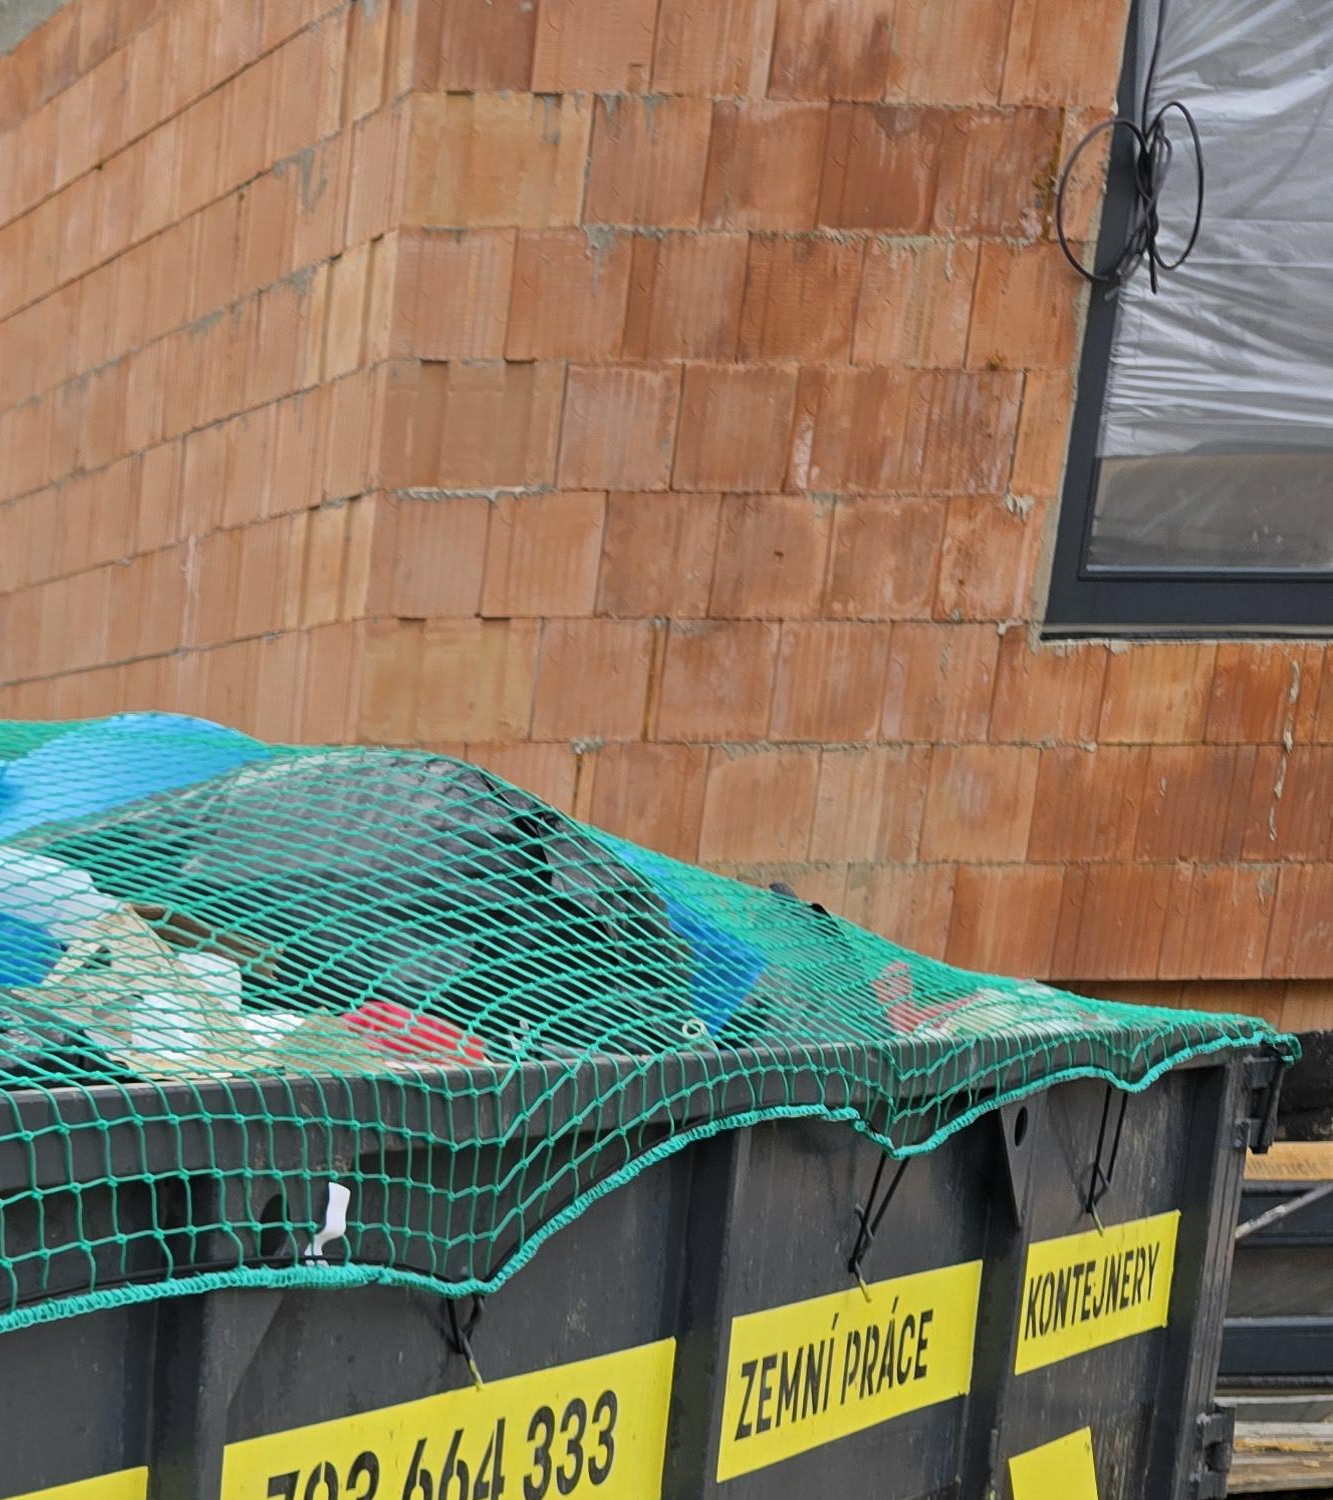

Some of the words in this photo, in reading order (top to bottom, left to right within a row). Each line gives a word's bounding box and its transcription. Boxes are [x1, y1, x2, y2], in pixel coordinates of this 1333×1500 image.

[1024, 1242, 1160, 1341] KONTEJNERY
[734, 1312, 839, 1442] ZEMNÍ
[840, 1296, 934, 1406] PRÁCE
